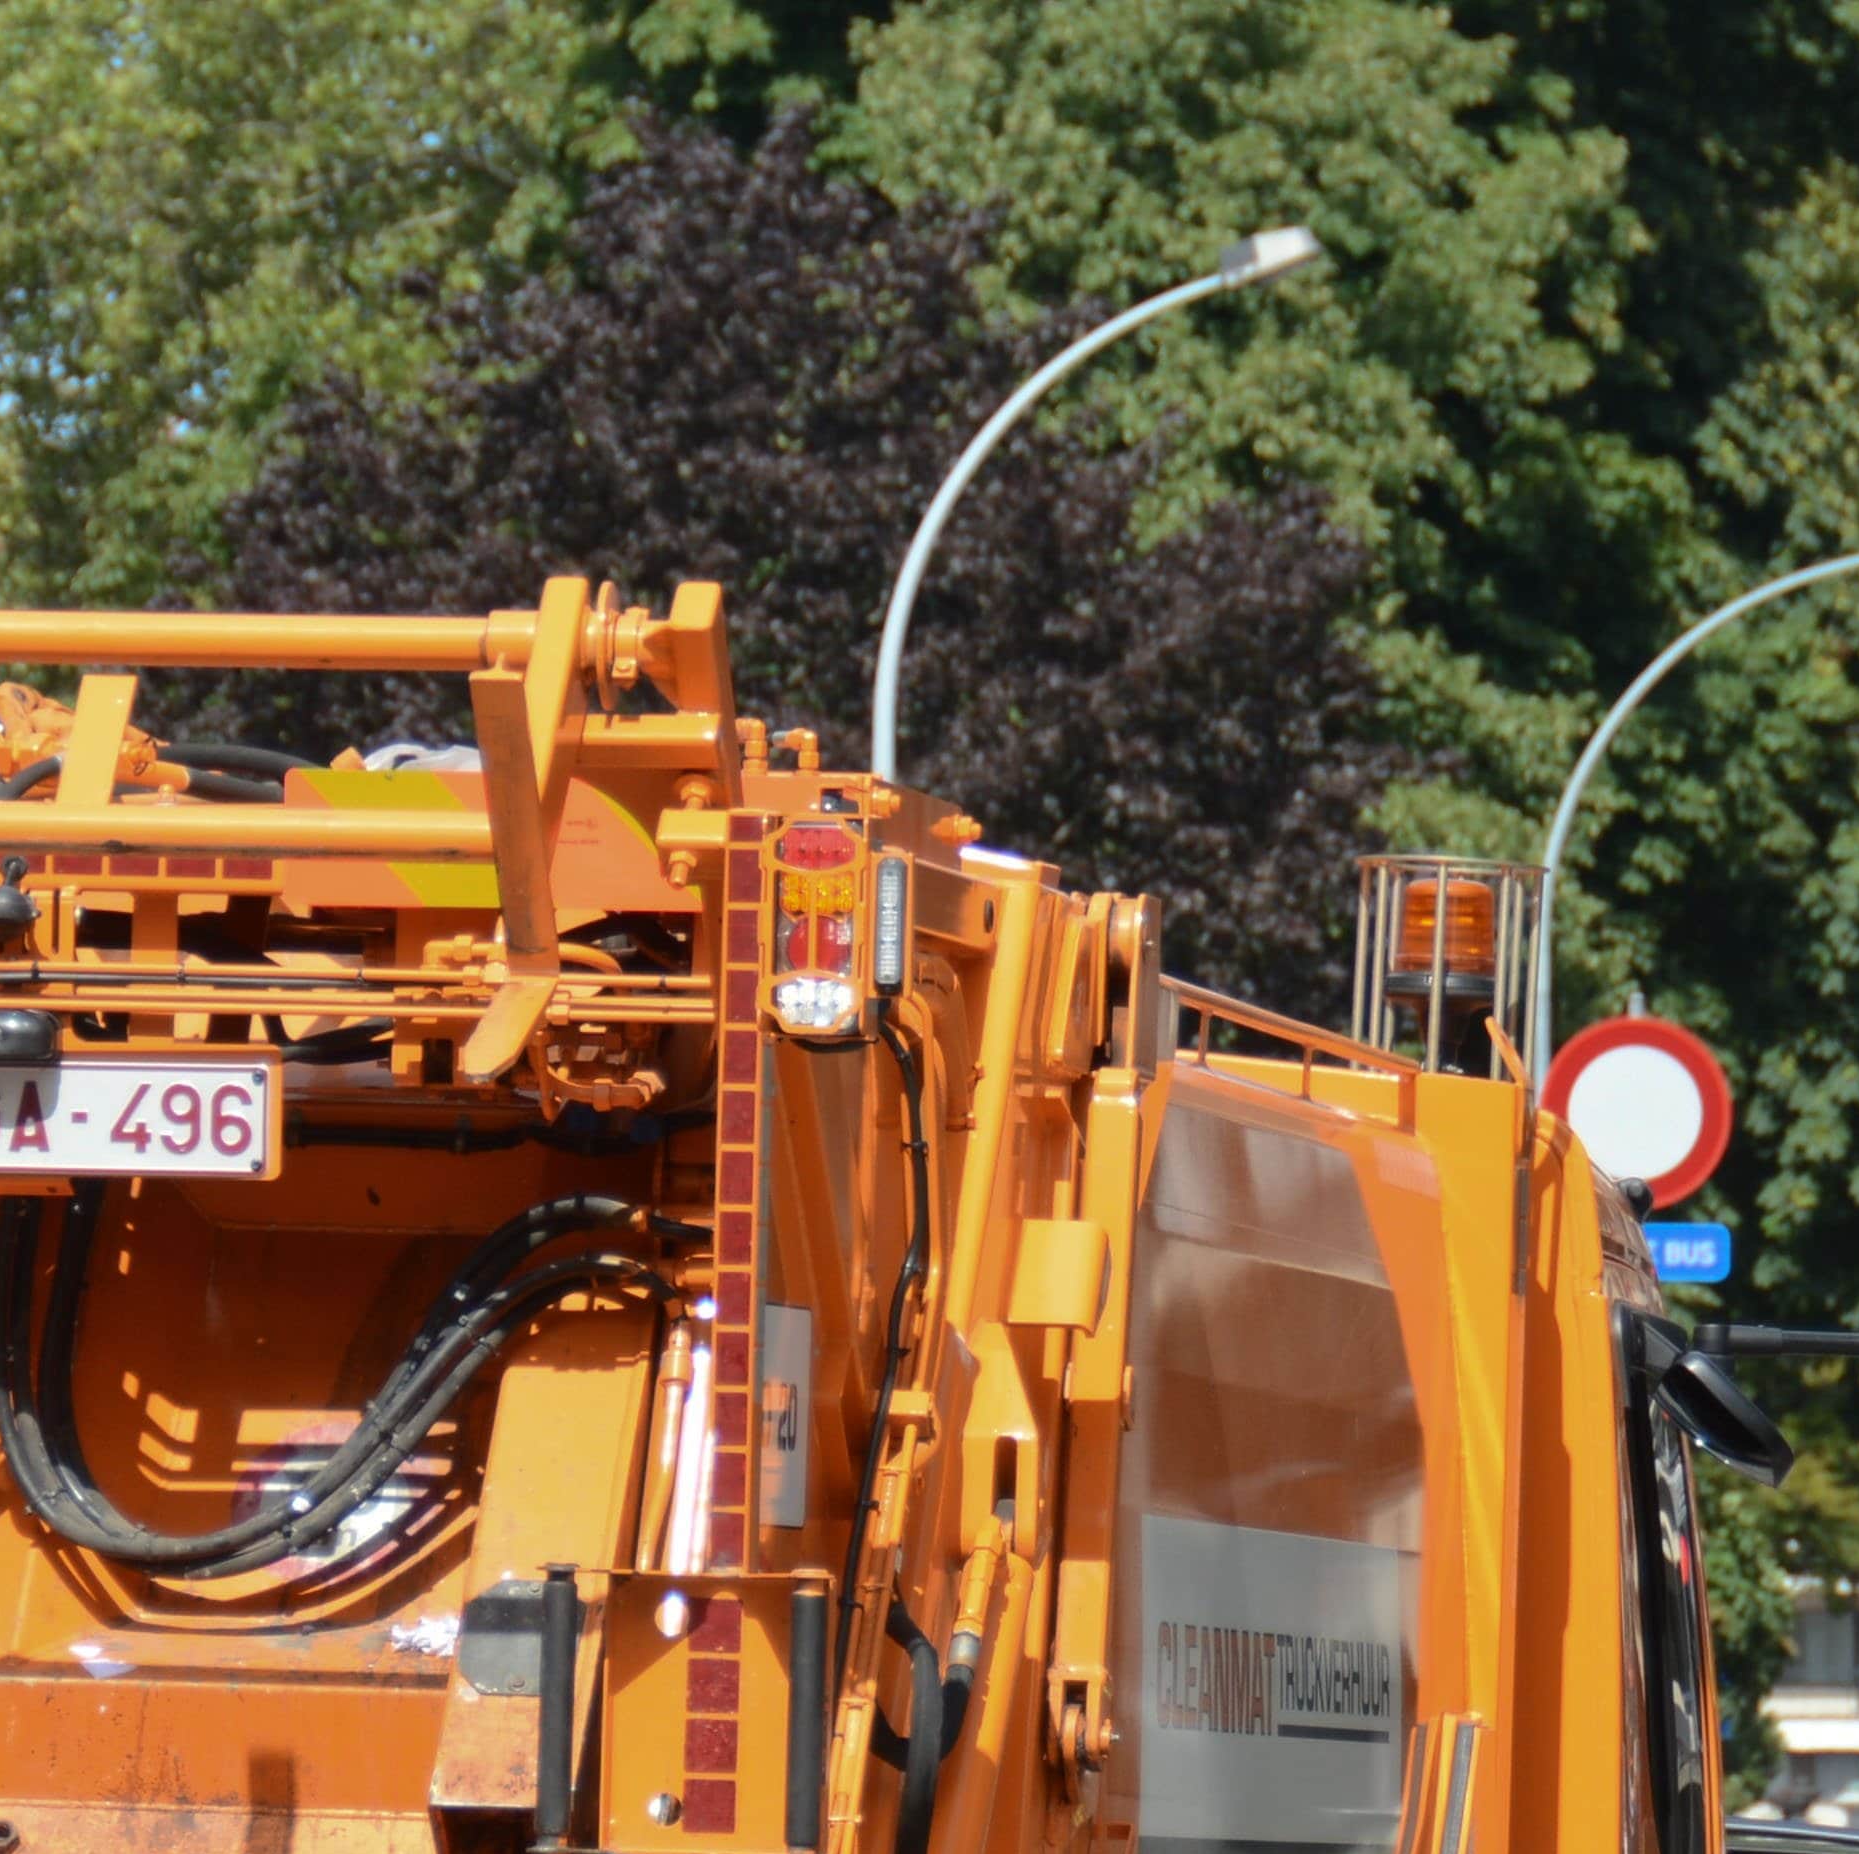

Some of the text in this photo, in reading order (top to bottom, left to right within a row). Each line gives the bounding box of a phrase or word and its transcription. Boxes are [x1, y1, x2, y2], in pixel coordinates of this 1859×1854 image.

[1663, 1239, 1717, 1267] BUS
[1155, 1620, 1391, 1737] CLEANMAT TRUCKVERHUUR
